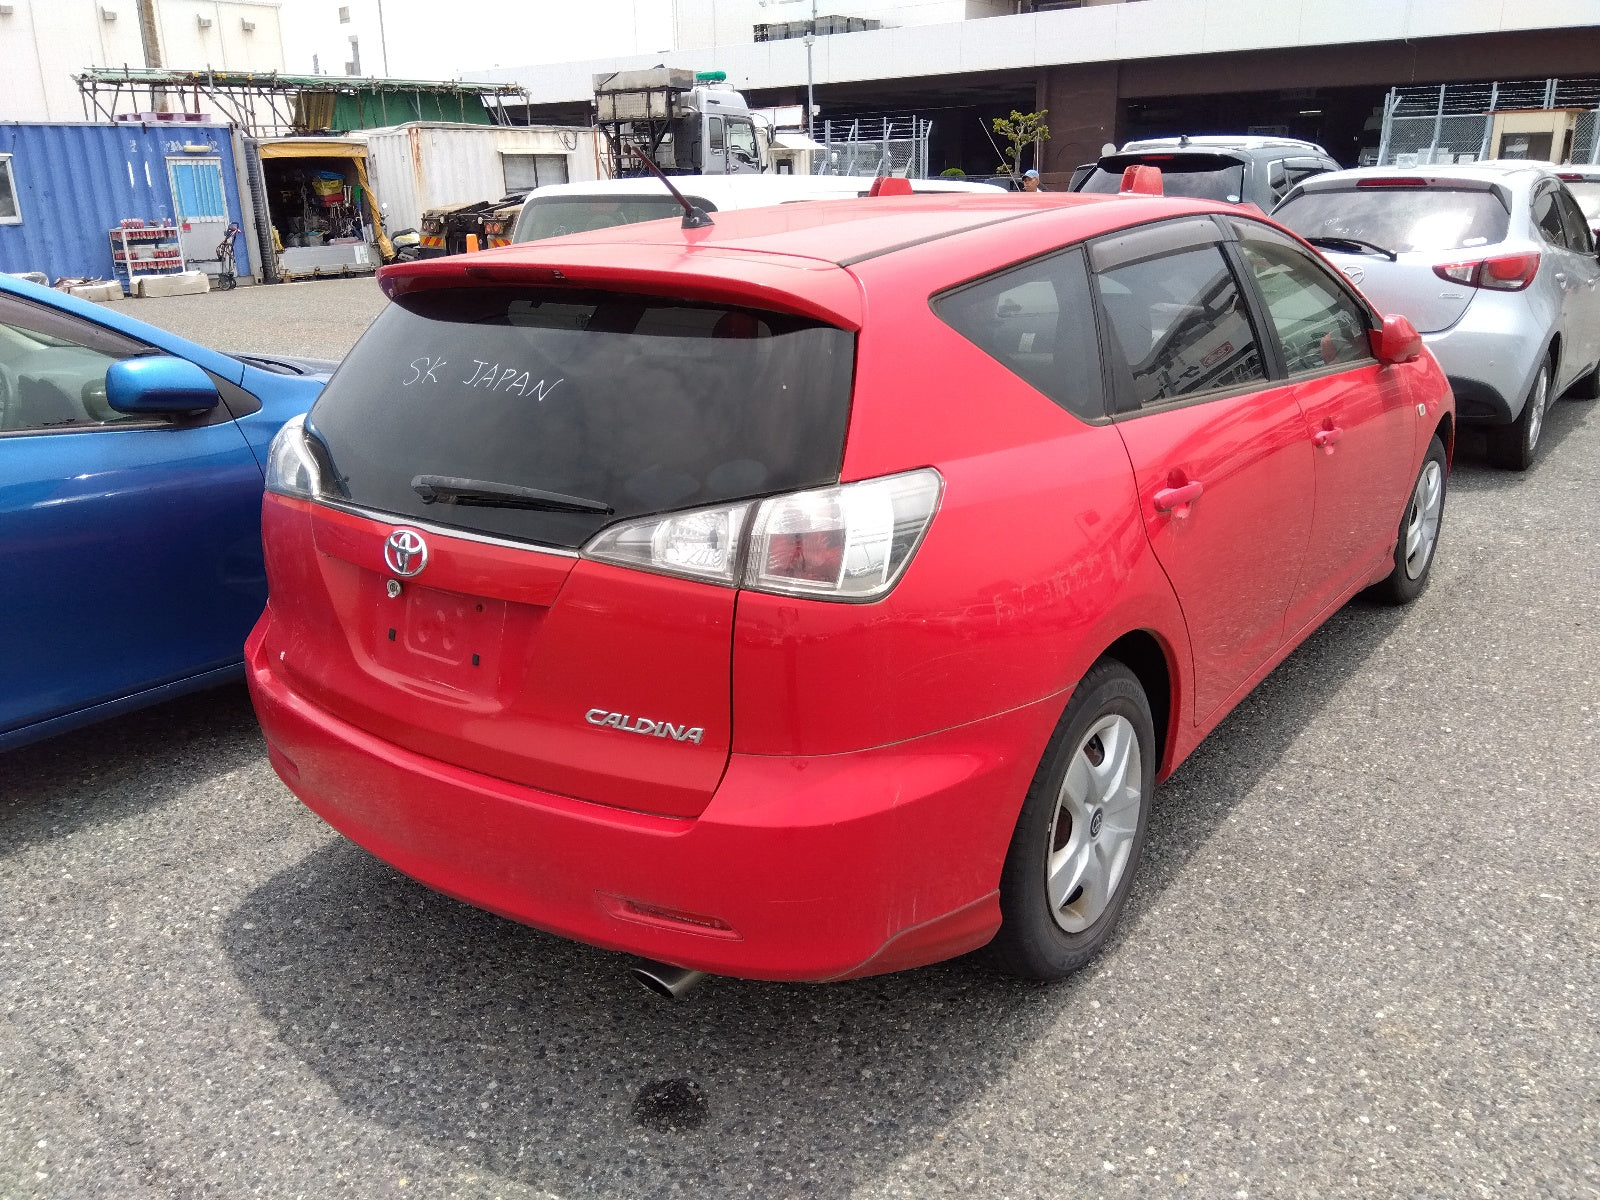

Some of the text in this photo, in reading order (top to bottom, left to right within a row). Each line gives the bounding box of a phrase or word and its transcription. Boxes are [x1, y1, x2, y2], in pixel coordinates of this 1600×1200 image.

[403, 356, 564, 402] SK JAPAN
[585, 708, 705, 745] CALDINA
